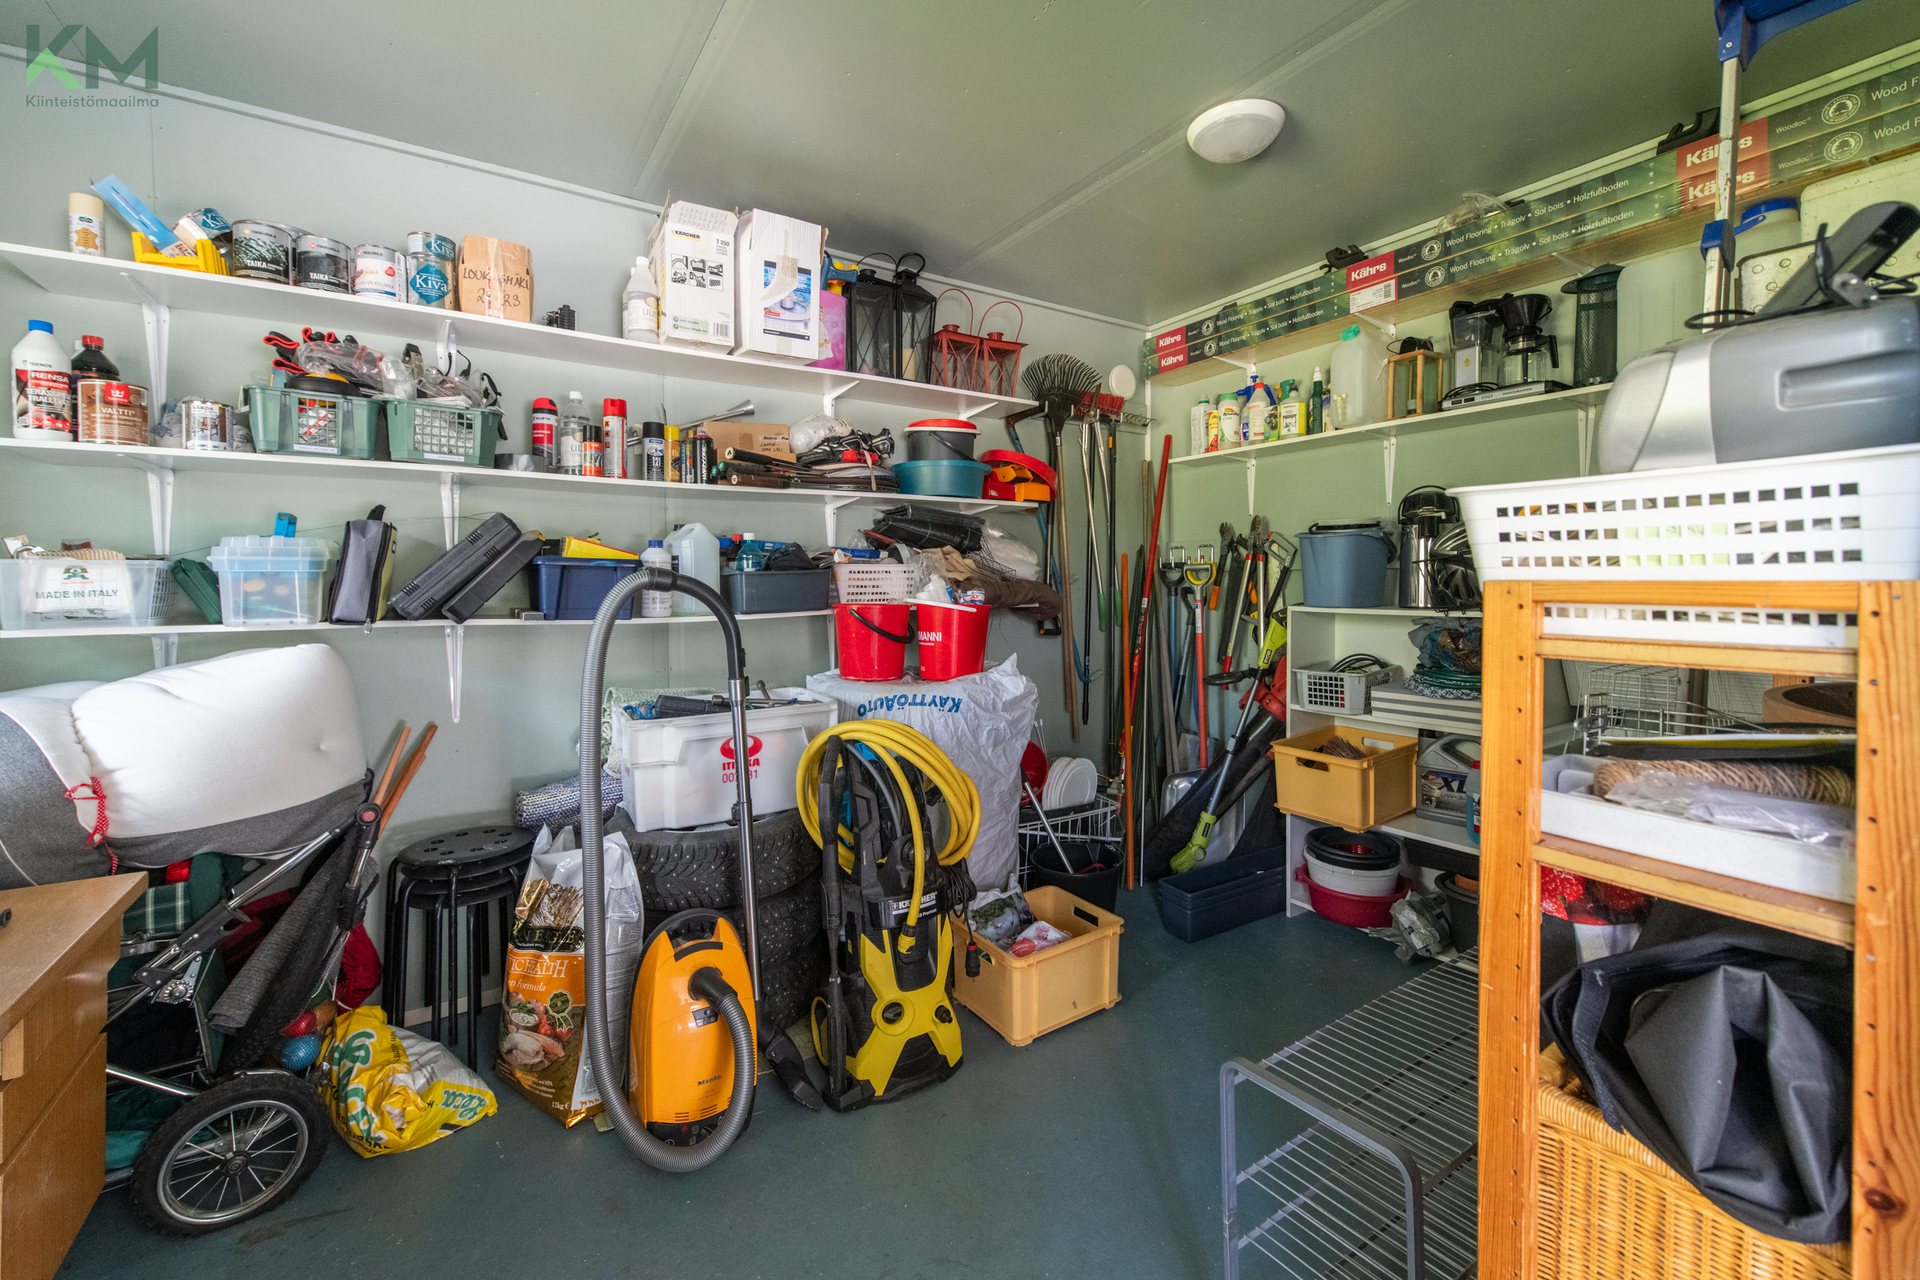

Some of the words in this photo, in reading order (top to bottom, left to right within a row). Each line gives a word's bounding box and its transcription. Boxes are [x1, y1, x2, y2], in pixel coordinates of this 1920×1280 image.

[1871, 80, 1907, 100] Wood
[1874, 121, 1910, 139] Wood
[1445, 234, 1464, 247] Wood
[1465, 225, 1492, 241] Flooring
[1500, 214, 1526, 229] Trägolv
[1534, 207, 1546, 217] Sol
[1548, 201, 1564, 213] bois
[1573, 179, 1629, 204] Holzfußboden
[1450, 260, 1469, 274] Wood
[1470, 253, 1497, 269] Flooring
[1504, 242, 1531, 257] Trägolv
[1538, 236, 1551, 246] Sol
[1552, 230, 1569, 242] bois
[1577, 210, 1634, 233] Holzfußboden
[246, 260, 267, 269] TAIKA
[1351, 262, 1387, 282] Kährs
[309, 272, 329, 280] TAIKA
[416, 274, 447, 293] Kiva
[1159, 333, 1182, 348] Kährs
[1161, 353, 1184, 367] Kährs
[31, 372, 69, 383] RENSA
[35, 590, 70, 600] MADE
[73, 590, 85, 598] IN
[88, 589, 119, 598] ITALY
[857, 693, 962, 717] KÄYTTÖAUTO
[722, 757, 761, 771] ITIKA
[535, 929, 576, 944] EAGLE
[524, 959, 569, 978] HEALTH
[697, 1074, 721, 1087] Miele
[439, 1089, 488, 1121] Leca
